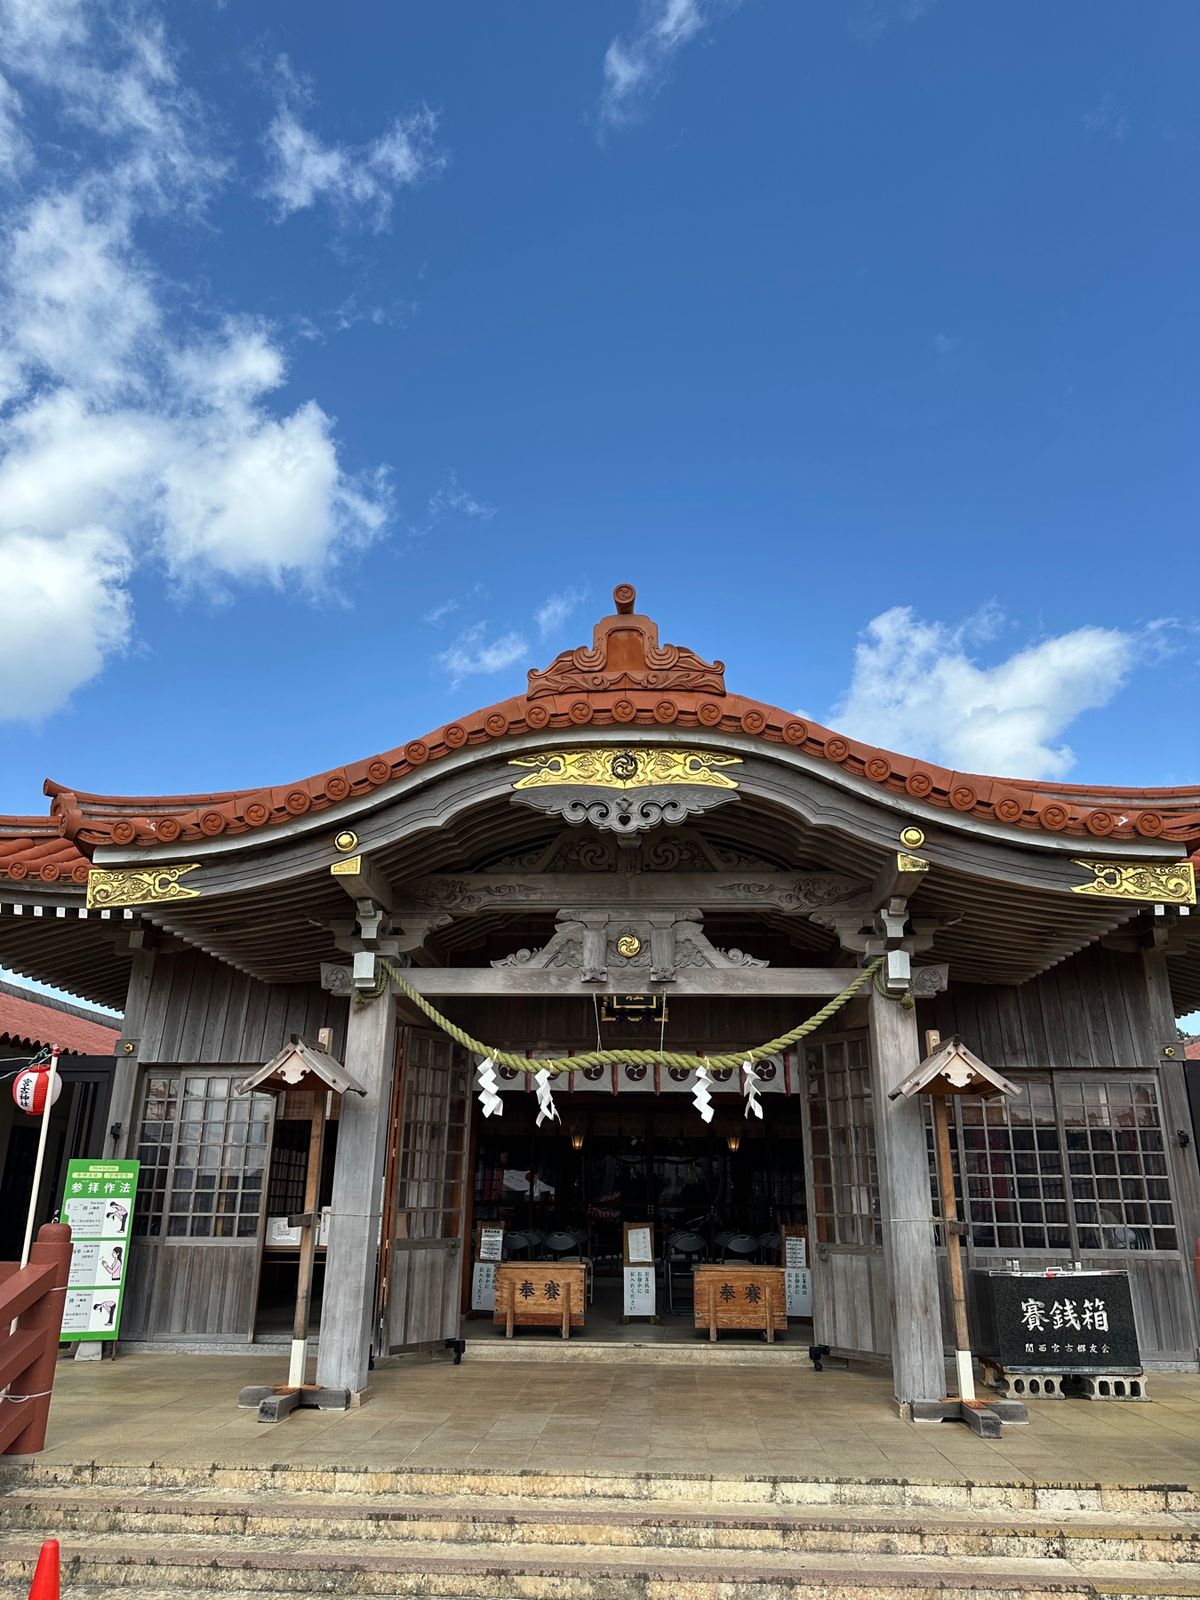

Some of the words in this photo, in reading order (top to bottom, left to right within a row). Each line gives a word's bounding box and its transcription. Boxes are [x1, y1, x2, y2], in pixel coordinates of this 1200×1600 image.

[71, 1182, 131, 1193] 参拝作法
[1021, 1298, 1109, 1332] 賽銭箱
